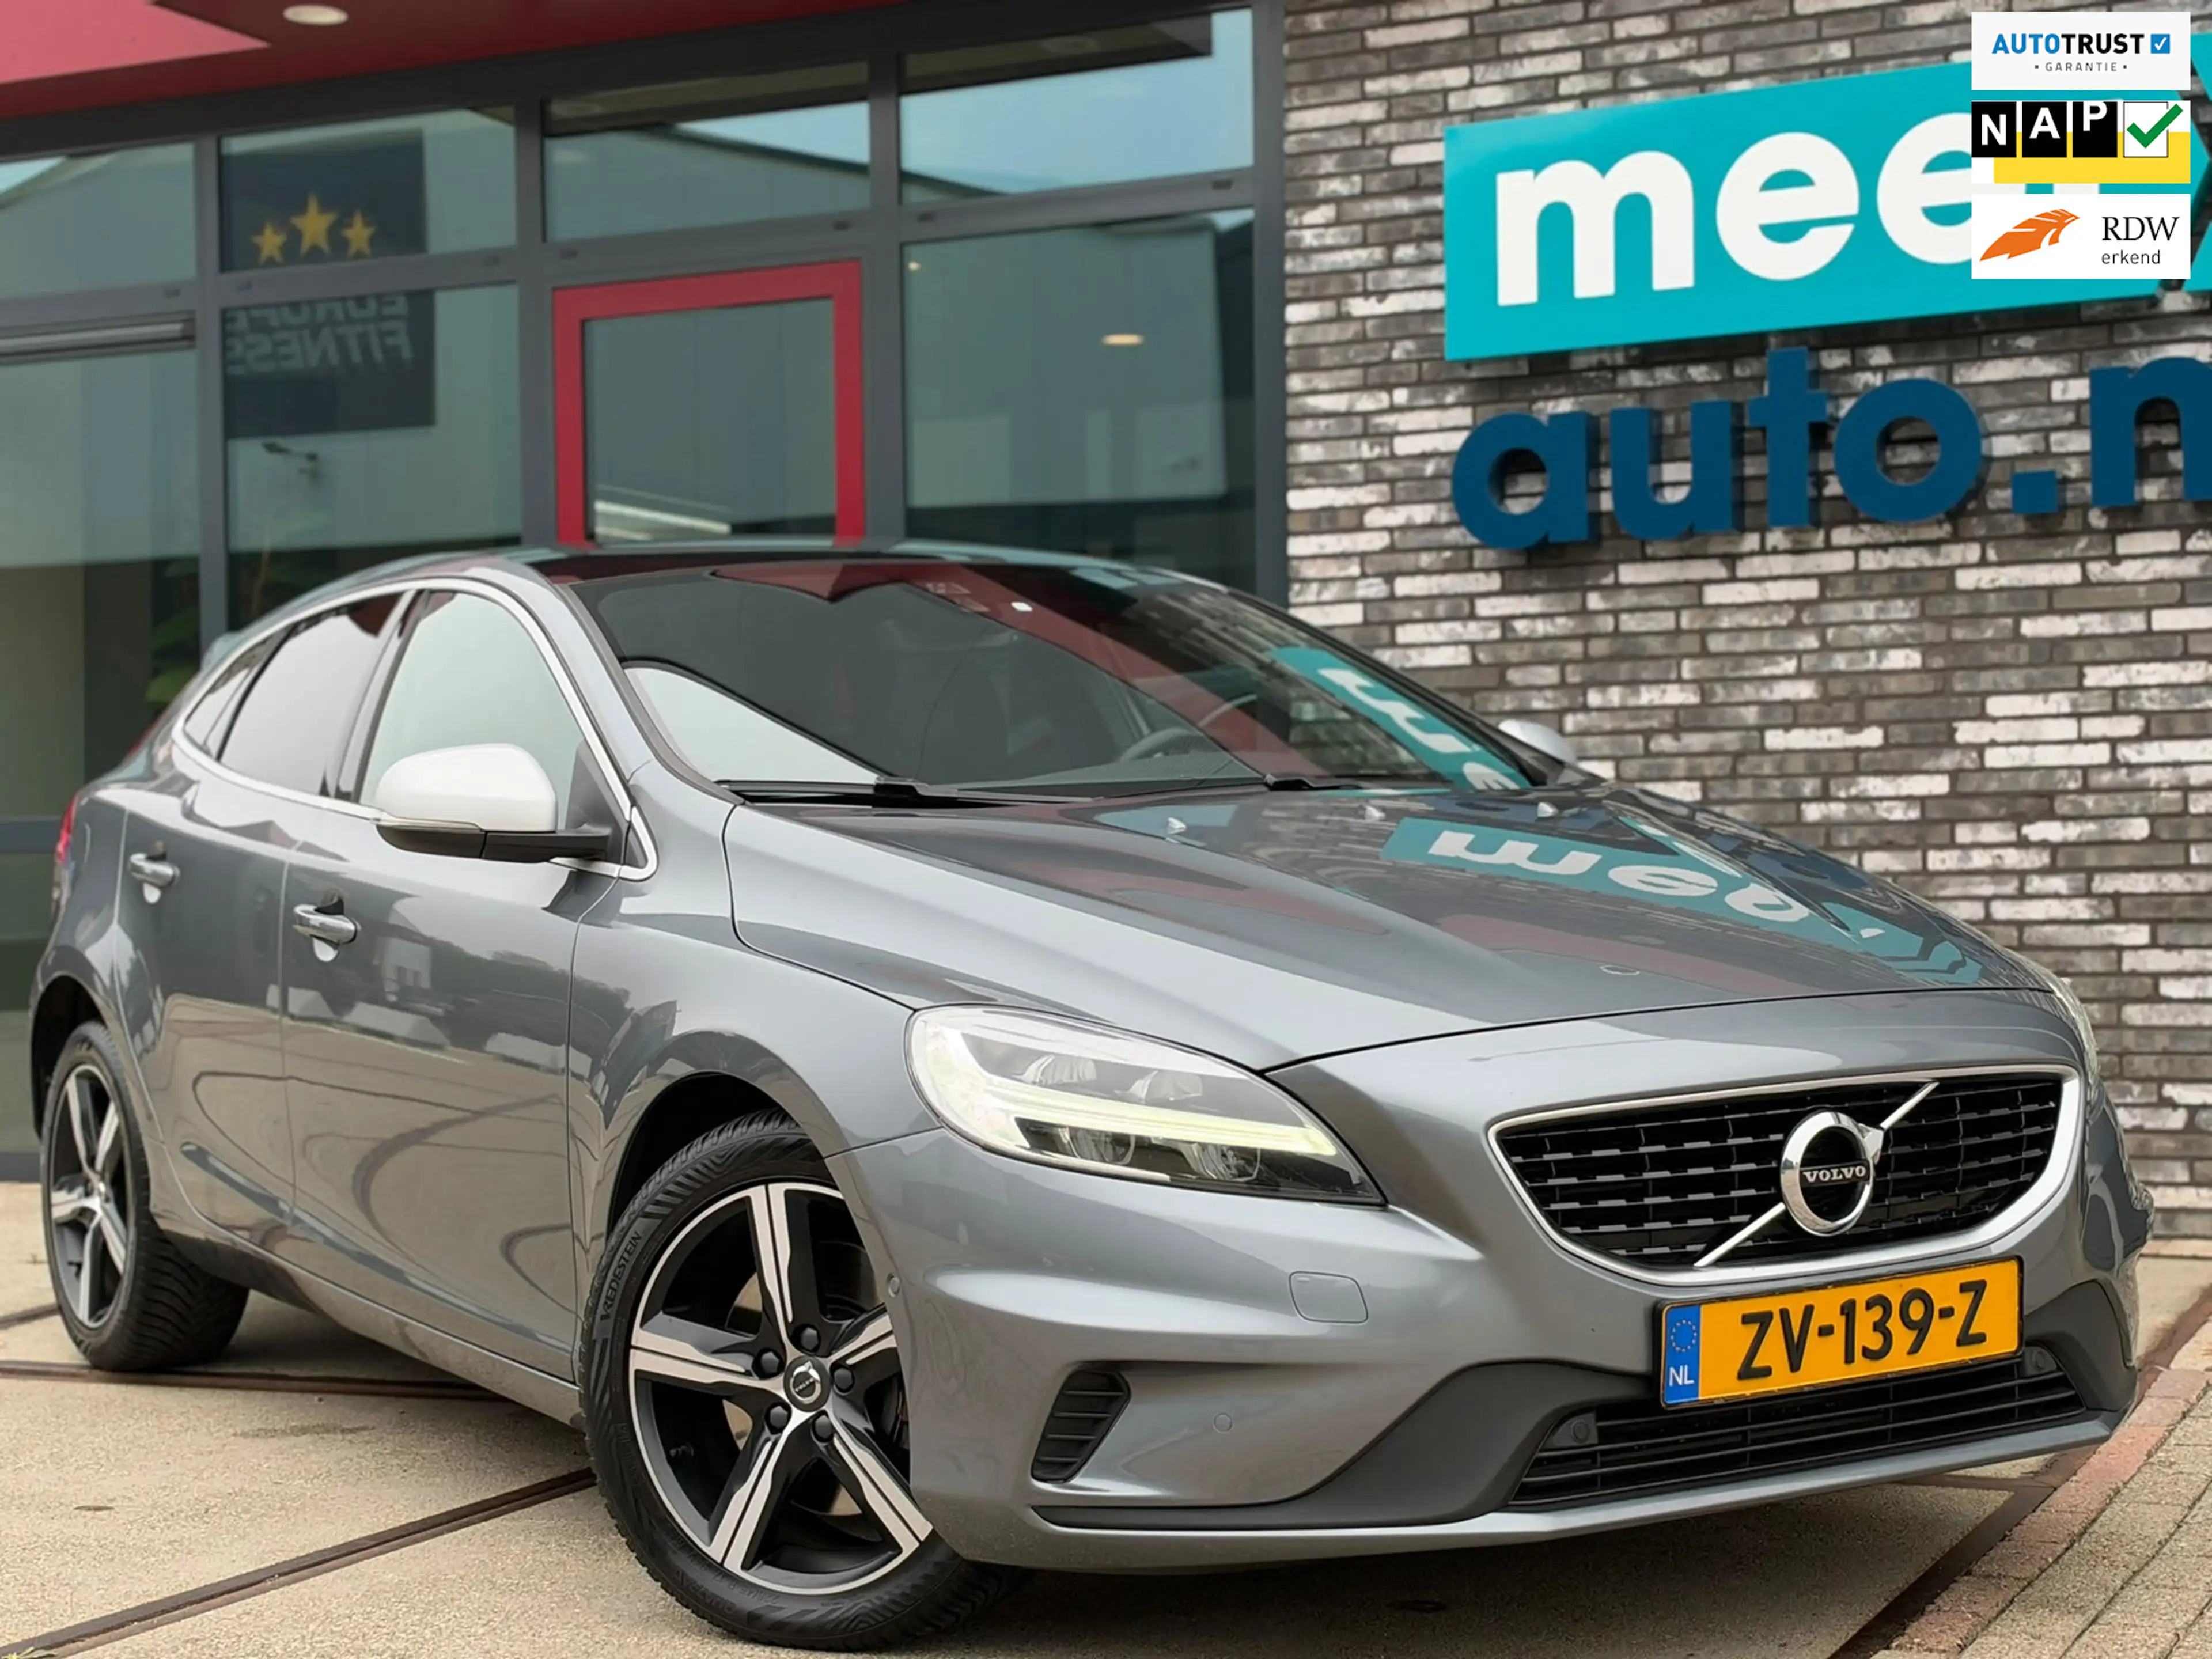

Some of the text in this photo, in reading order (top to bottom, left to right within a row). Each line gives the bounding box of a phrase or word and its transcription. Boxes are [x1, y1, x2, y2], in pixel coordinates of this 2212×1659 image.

[1497, 99, 2126, 307] mee
[1802, 1165, 1867, 1184] VOLVO
[600, 1230, 642, 1321] VREDESTEIN
[1737, 1279, 1988, 1381] ZV-139-Z
[1668, 1365, 1695, 1387] NL
